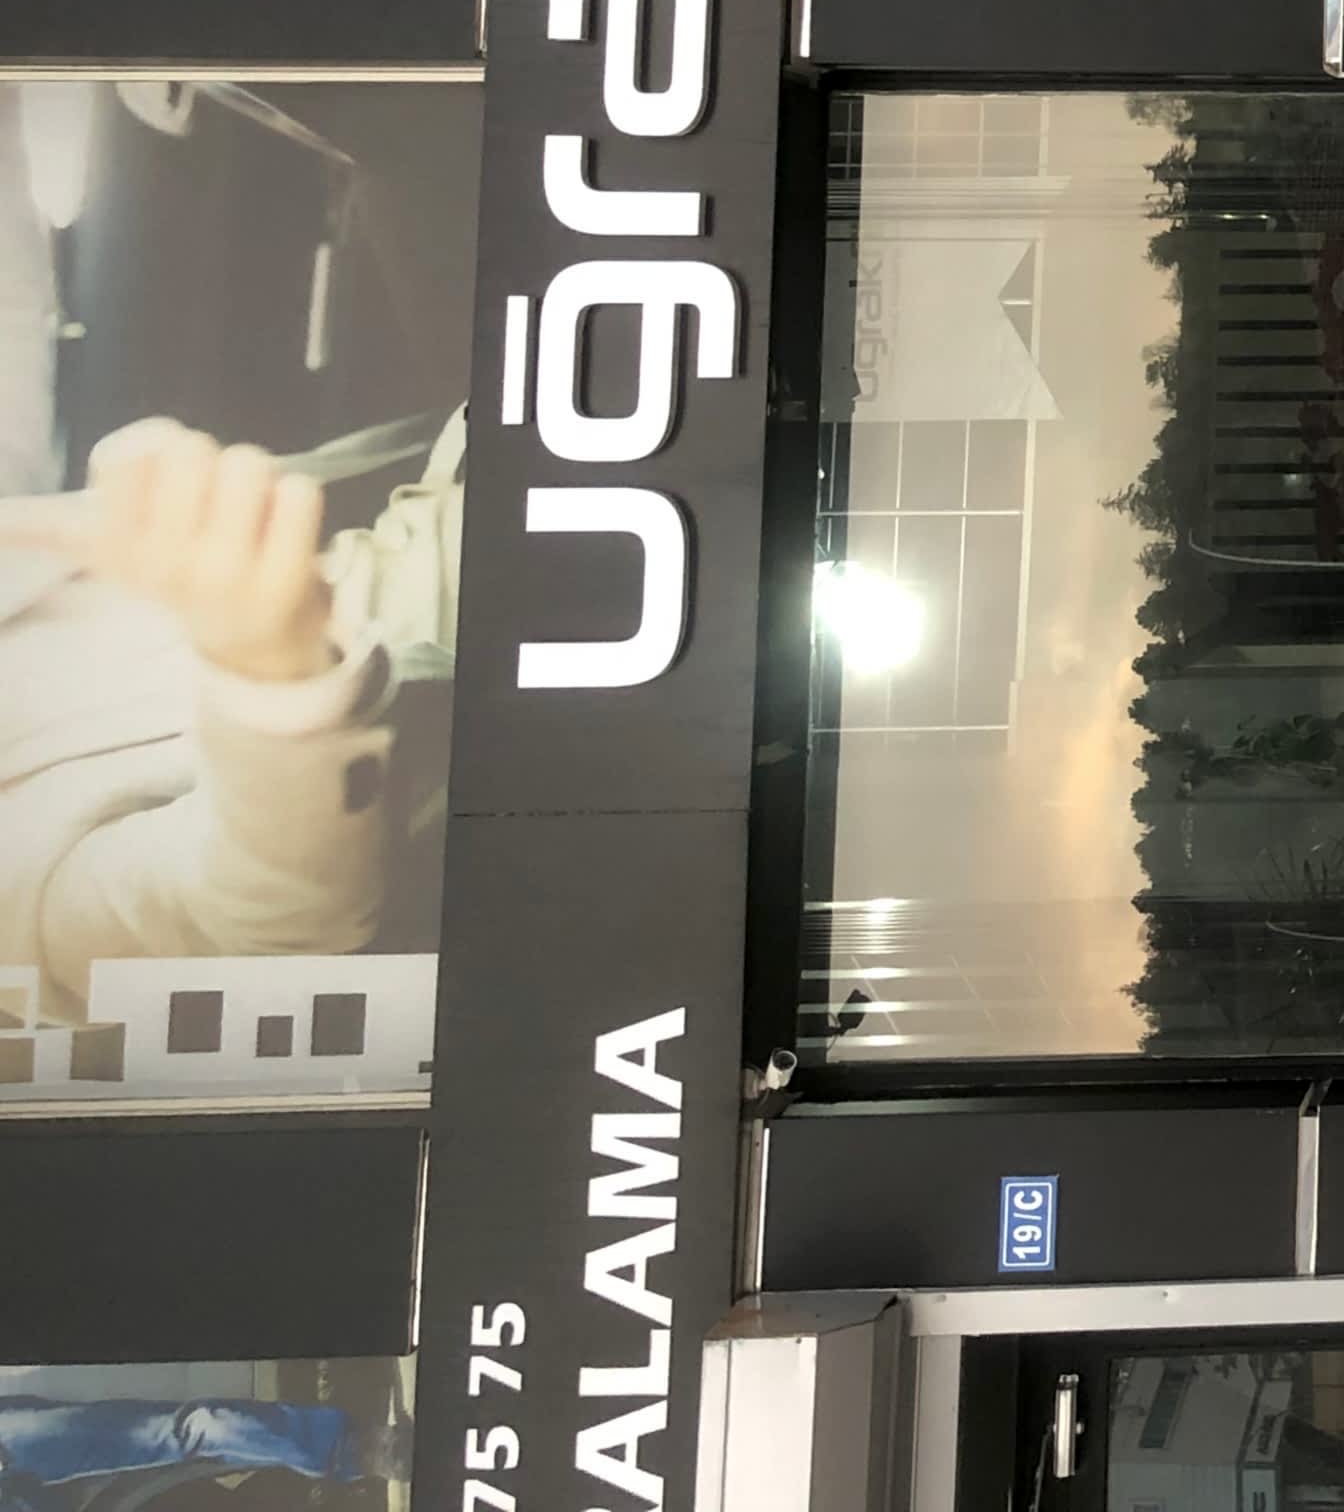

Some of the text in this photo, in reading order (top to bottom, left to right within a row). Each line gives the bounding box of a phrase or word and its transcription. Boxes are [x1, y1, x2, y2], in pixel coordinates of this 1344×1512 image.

[574, 1006, 686, 1512] ALAMA
[1012, 1190, 1043, 1259] 19/C
[463, 1302, 526, 1512] 75 75
